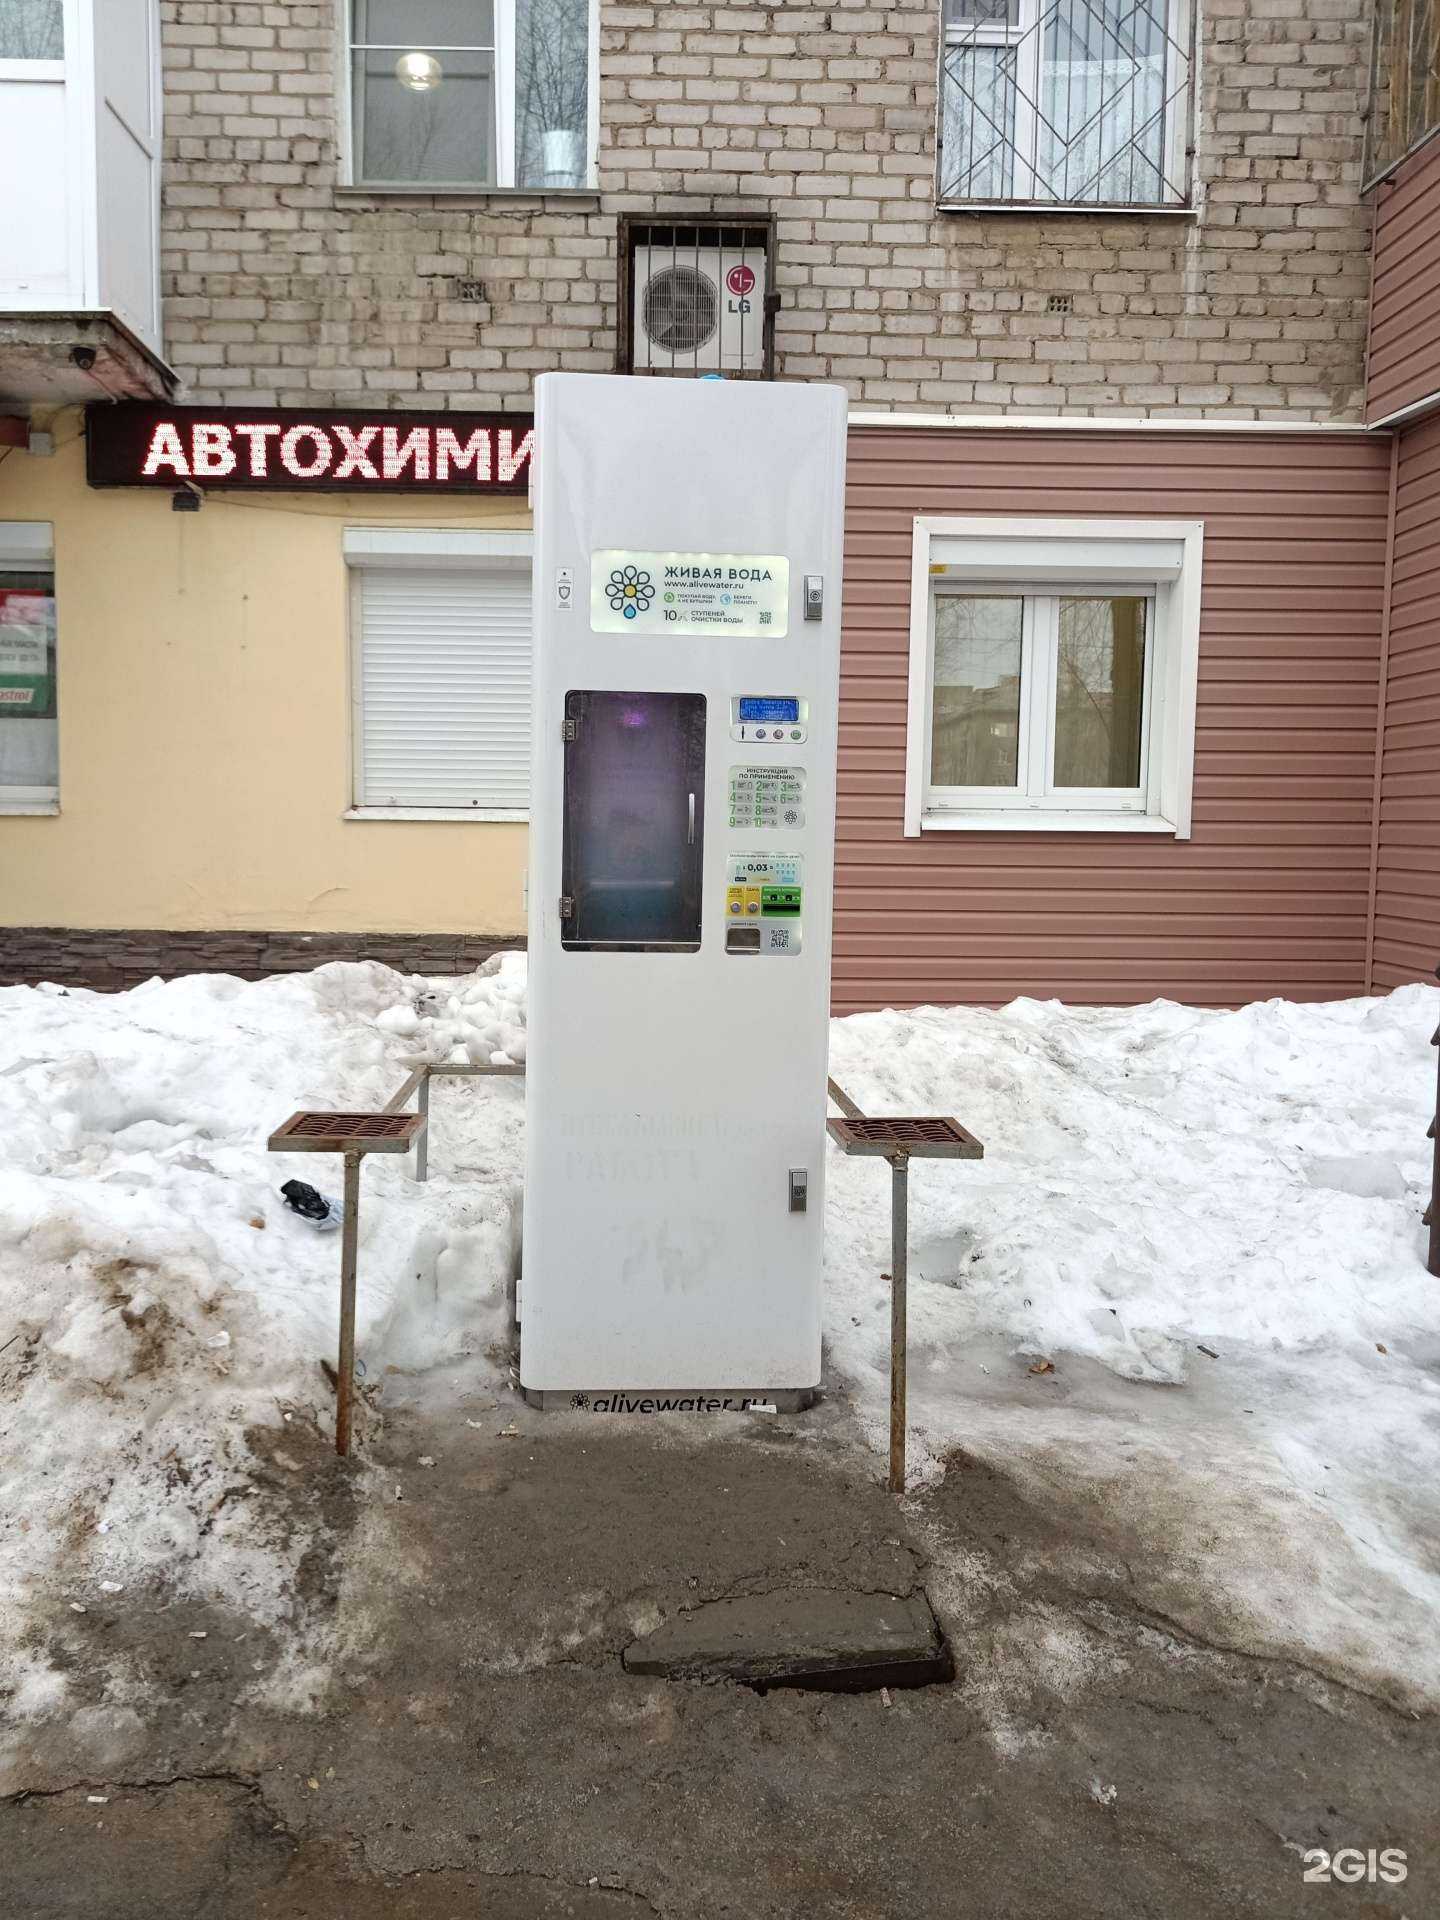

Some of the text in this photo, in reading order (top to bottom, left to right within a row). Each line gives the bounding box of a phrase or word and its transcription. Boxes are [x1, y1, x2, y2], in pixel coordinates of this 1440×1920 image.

[728, 299, 751, 314] LG
[664, 566, 772, 582] ЖИВАЯ ВОДА
[664, 580, 744, 589] www.alivewater.ru
[664, 609, 677, 621] 10
[747, 863, 768, 872] 0,03
